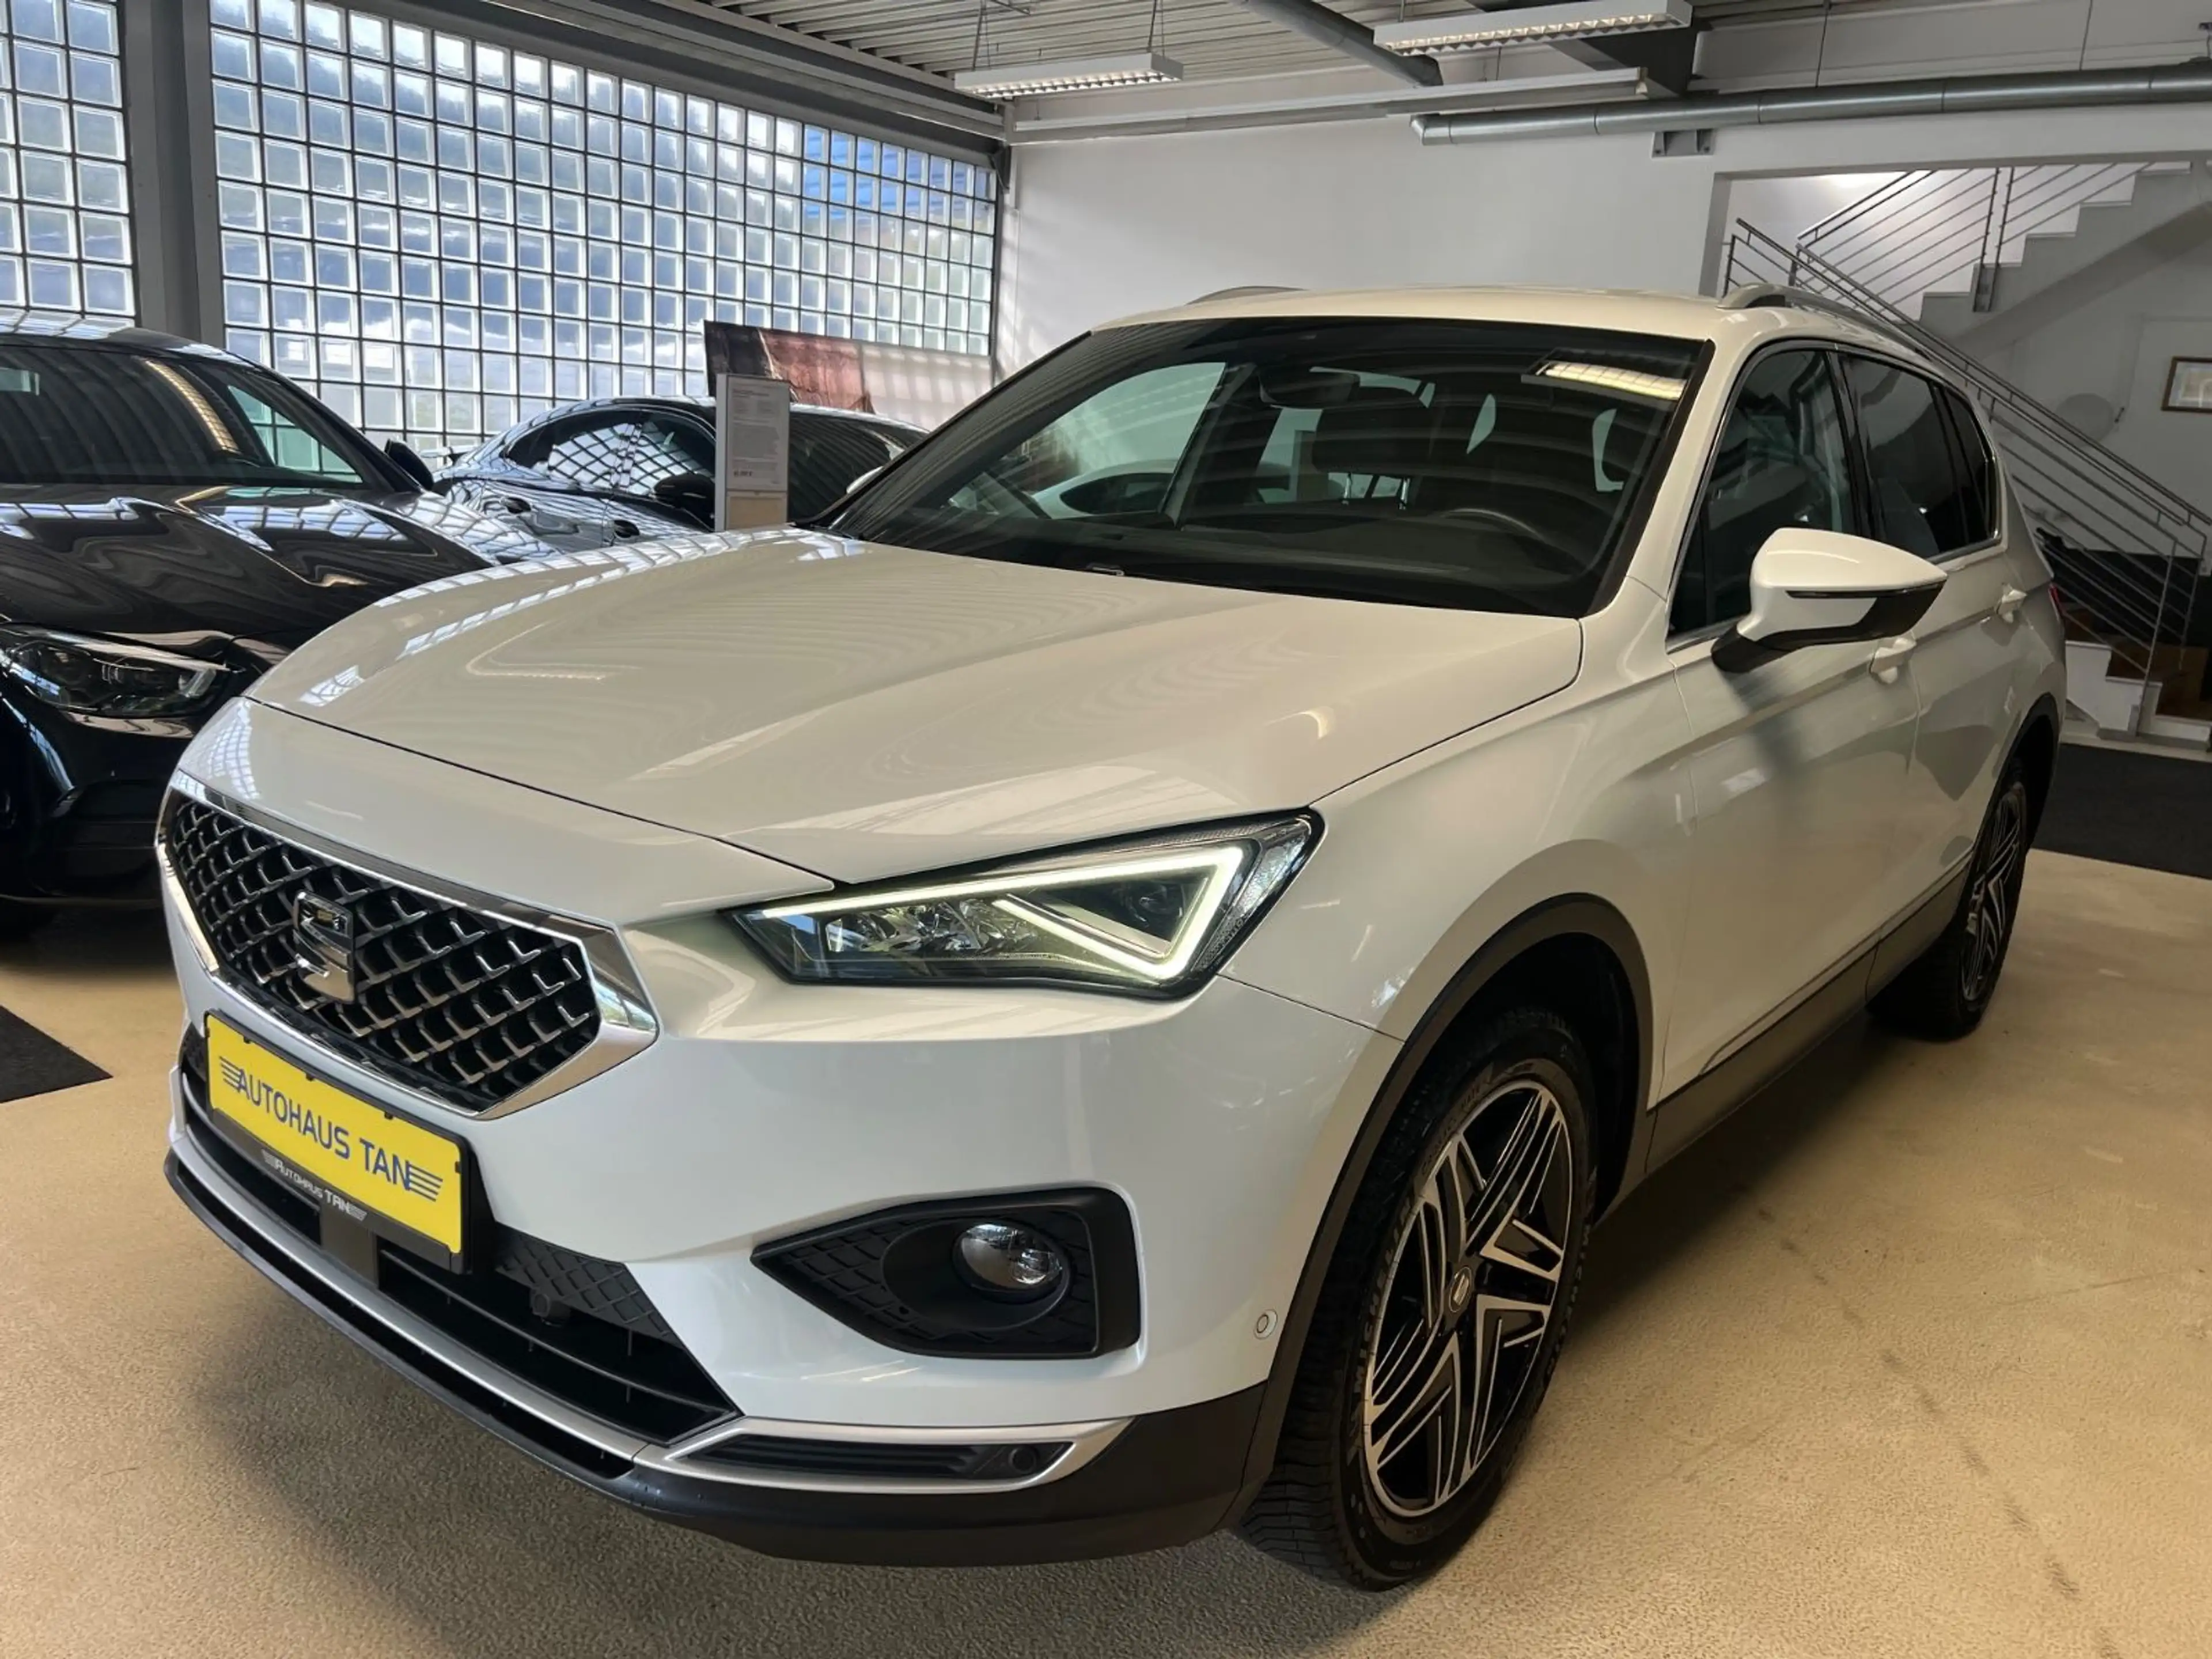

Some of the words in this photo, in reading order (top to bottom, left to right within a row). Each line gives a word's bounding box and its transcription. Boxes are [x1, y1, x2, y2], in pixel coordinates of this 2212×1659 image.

[238, 1068, 350, 1160] AUTOHAUS
[359, 1137, 412, 1191] TAN
[324, 1188, 350, 1214] TAN
